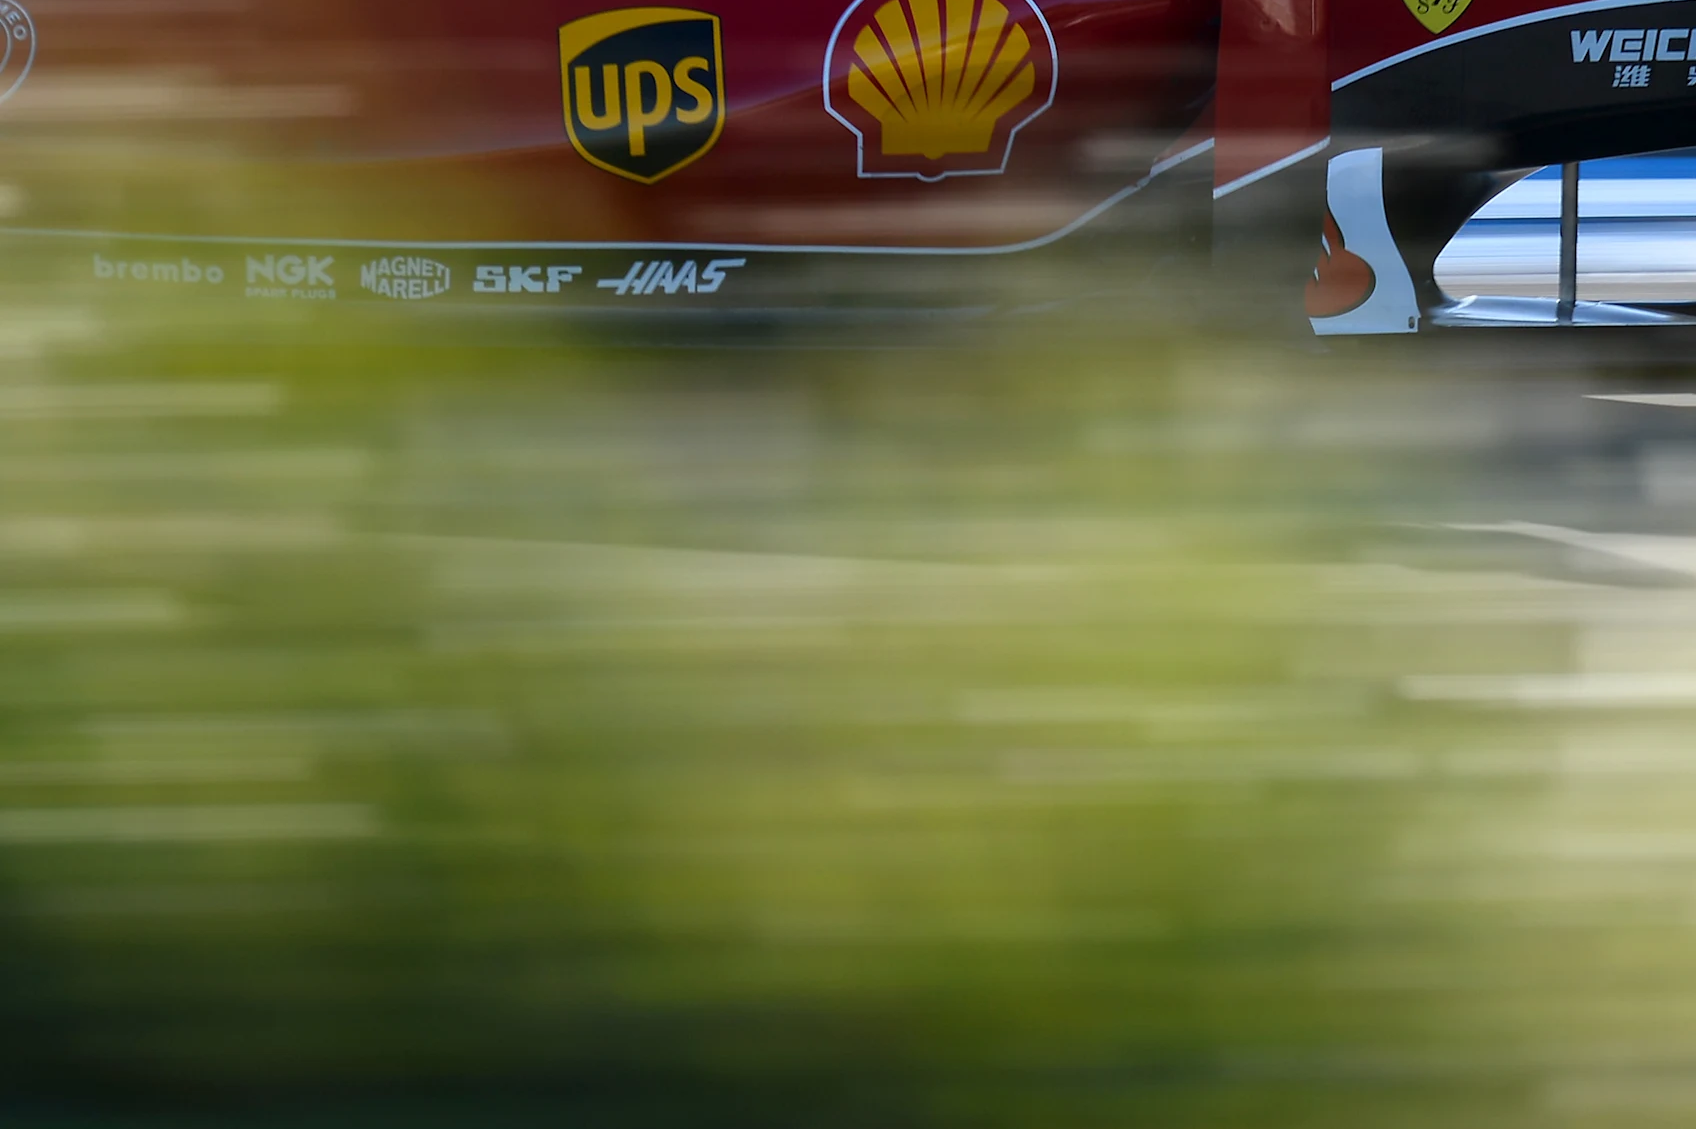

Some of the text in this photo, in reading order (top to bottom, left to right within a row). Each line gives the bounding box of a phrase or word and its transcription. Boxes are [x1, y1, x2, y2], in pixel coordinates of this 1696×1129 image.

[574, 56, 714, 157] ups
[93, 252, 224, 284] brembo
[245, 254, 335, 286] NGK
[361, 256, 451, 284] MAGNETI
[473, 266, 582, 293] SKF
[597, 258, 747, 295] HAAS
[361, 273, 451, 300] MARELLI
